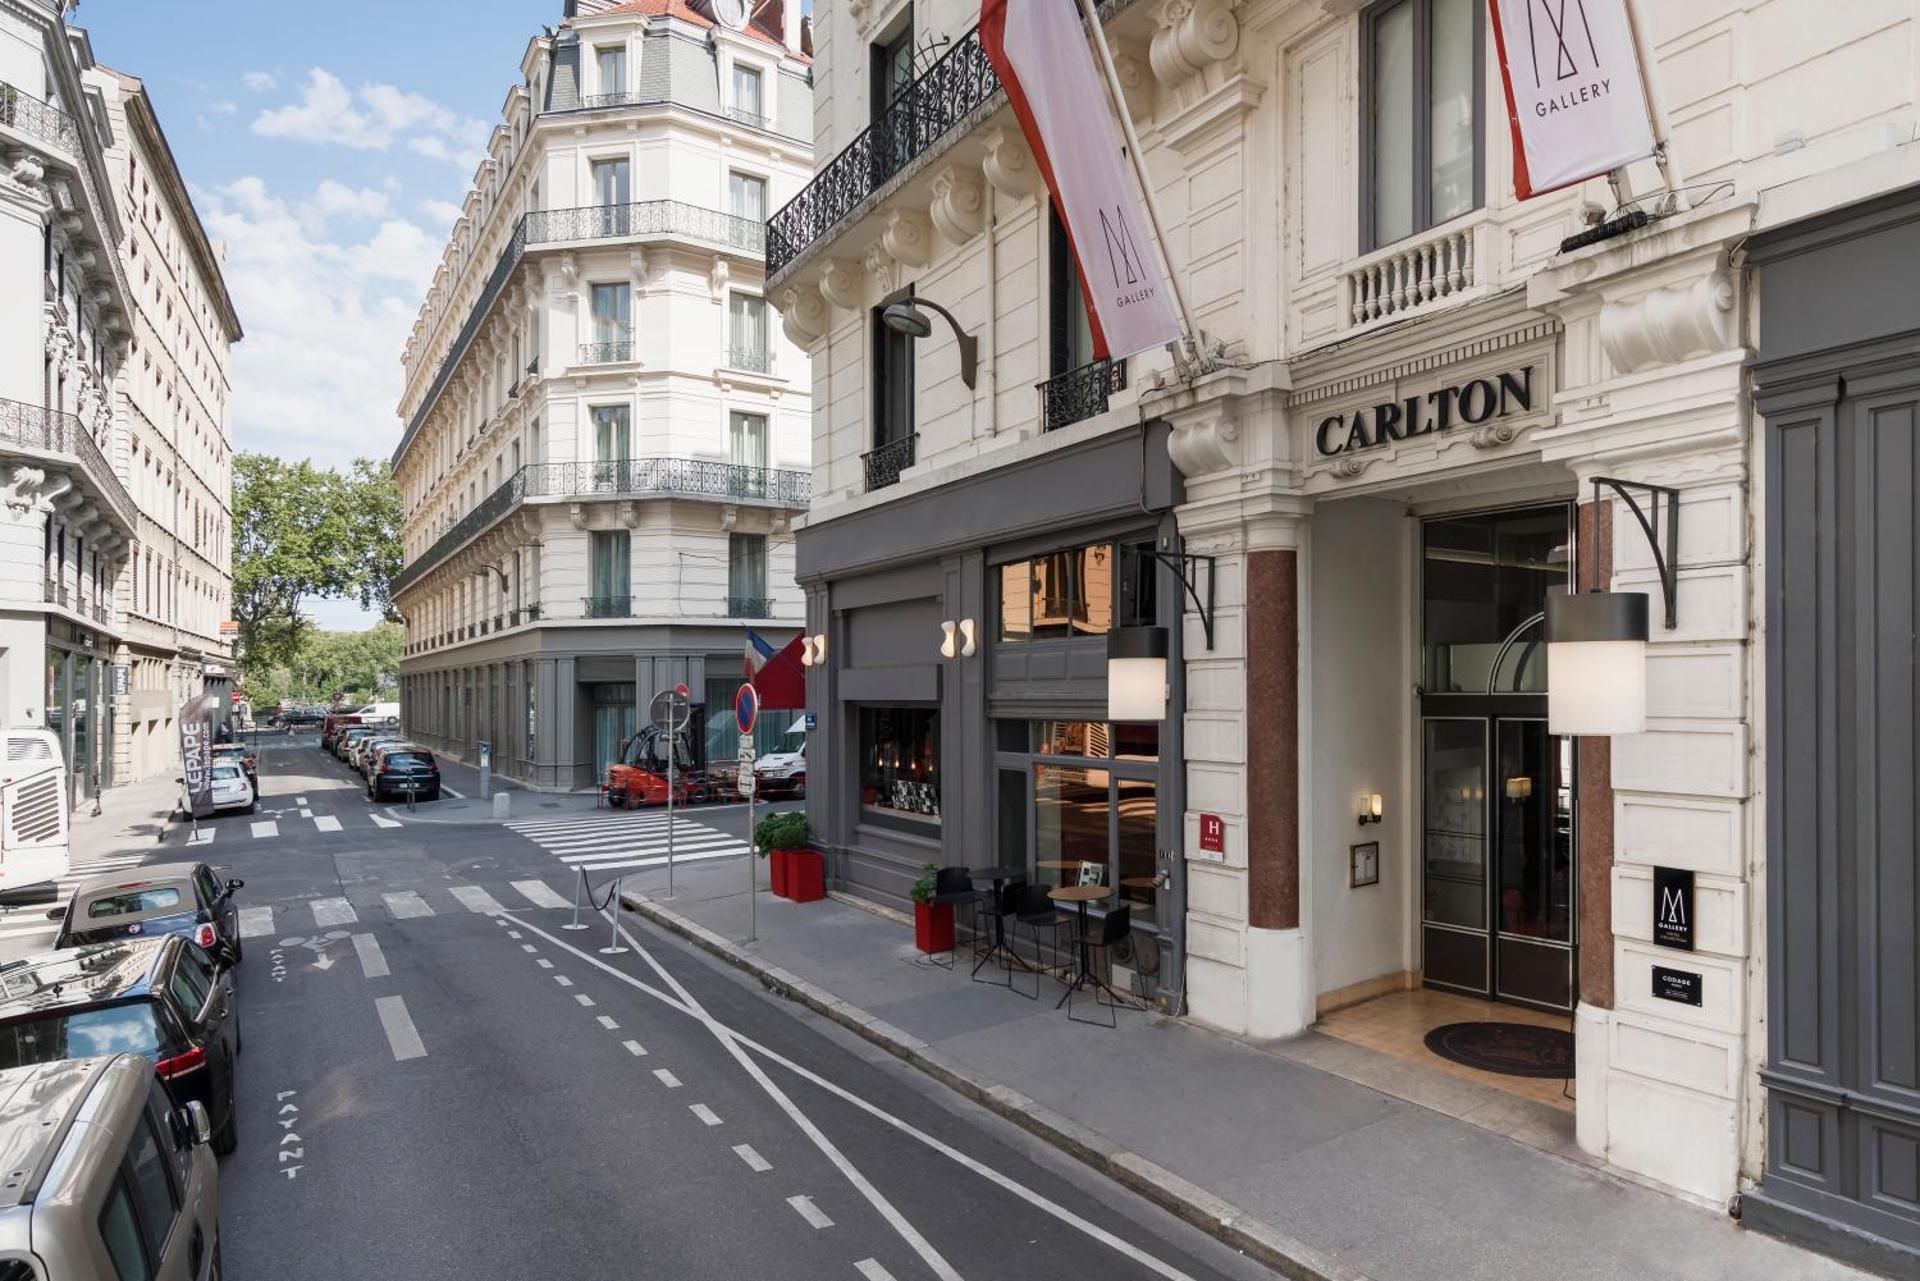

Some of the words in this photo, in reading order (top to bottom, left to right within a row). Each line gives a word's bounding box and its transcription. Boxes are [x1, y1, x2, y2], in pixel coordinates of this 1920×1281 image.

[1535, 79, 1611, 117] GALLERY
[1116, 287, 1155, 308] GALLERY
[1316, 366, 1533, 456] CARLTON
[117, 668, 125, 694] LEPAPE
[182, 722, 201, 793] LEPAPE
[1209, 820, 1219, 835] H
[1658, 921, 1688, 932] GALLERY
